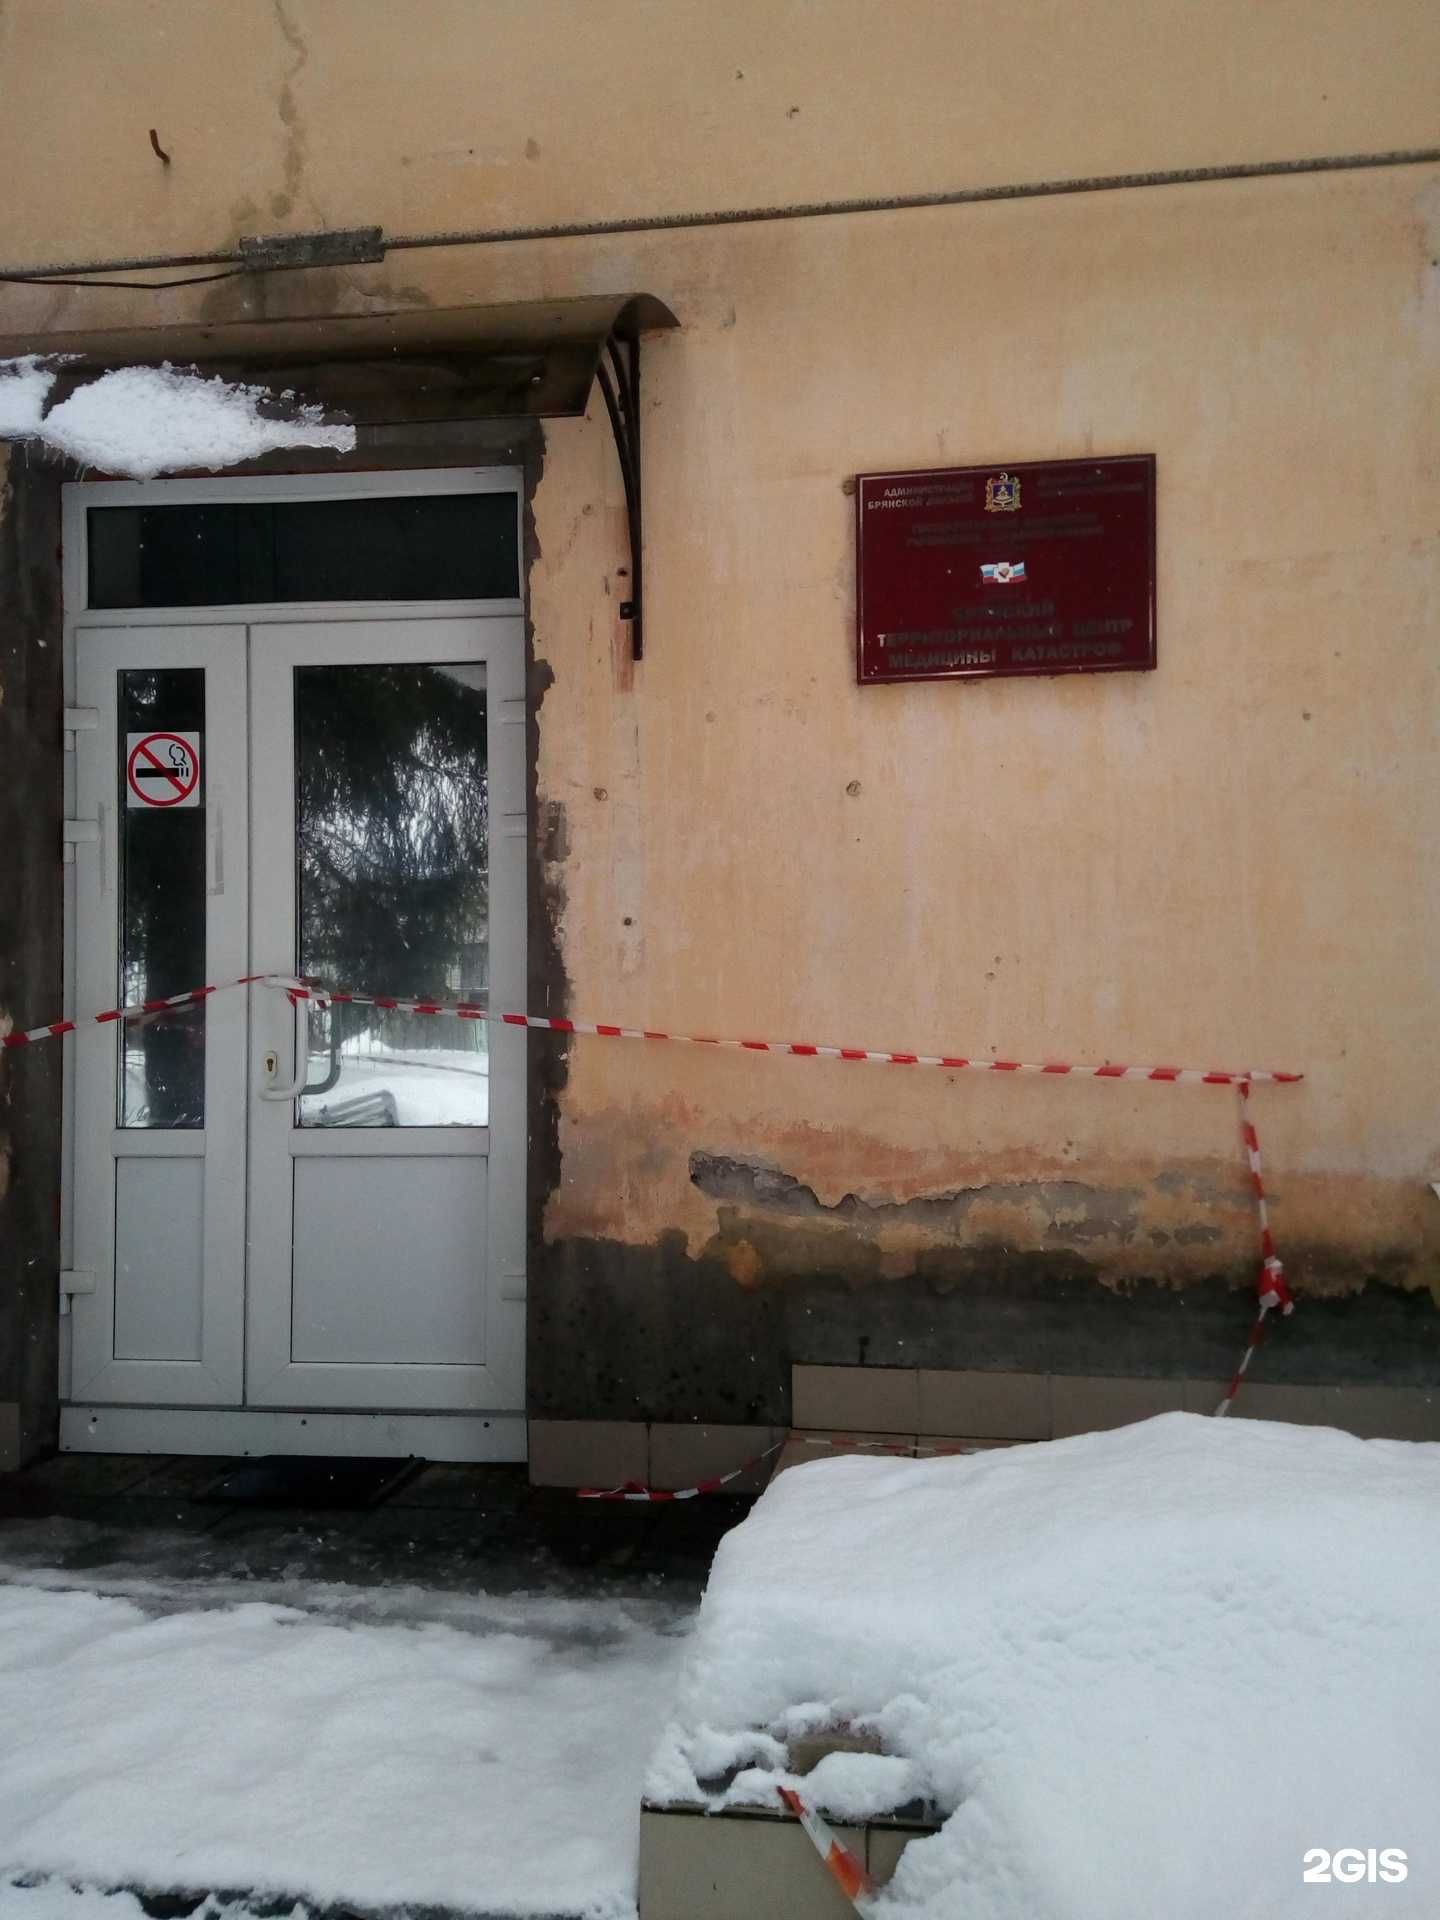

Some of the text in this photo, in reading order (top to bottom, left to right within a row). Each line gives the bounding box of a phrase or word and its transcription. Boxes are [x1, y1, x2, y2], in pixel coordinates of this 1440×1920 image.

[884, 482, 974, 497] АДМИНИСТР
[877, 623, 1064, 647] ТЕРРИТОРИАЛ
[888, 649, 997, 668] МЕДИЦИНЫ
